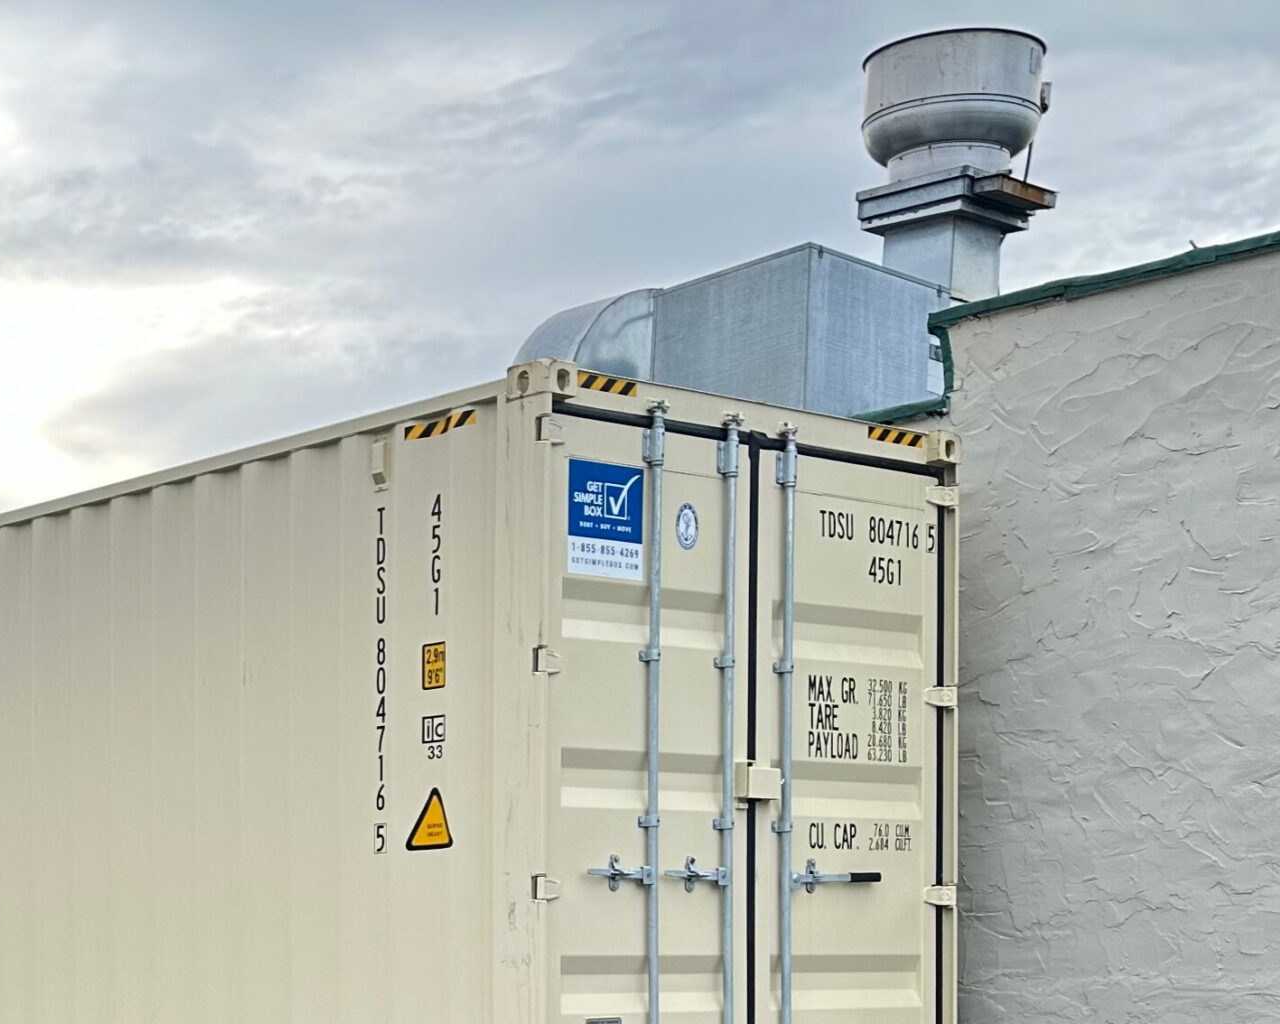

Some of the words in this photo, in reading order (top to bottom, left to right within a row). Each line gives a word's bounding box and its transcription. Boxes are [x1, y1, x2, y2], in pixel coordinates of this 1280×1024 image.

[586, 480, 603, 493] GET
[584, 505, 603, 518] BOX
[819, 509, 854, 541] TDSU
[868, 515, 919, 550] 804716
[927, 525, 936, 552] 5
[430, 493, 442, 616] 45G1
[571, 541, 639, 559] 1-855-855-4269
[376, 506, 386, 625] TDSU
[868, 556, 902, 586] 45G1
[807, 674, 836, 703] MAX.
[840, 677, 859, 705] GR.
[375, 637, 386, 811] 804716
[808, 703, 840, 731] TARE
[427, 744, 443, 760] 33
[807, 730, 859, 760] PAYLOAD
[808, 822, 827, 850] CU.
[833, 822, 860, 850] CAP.
